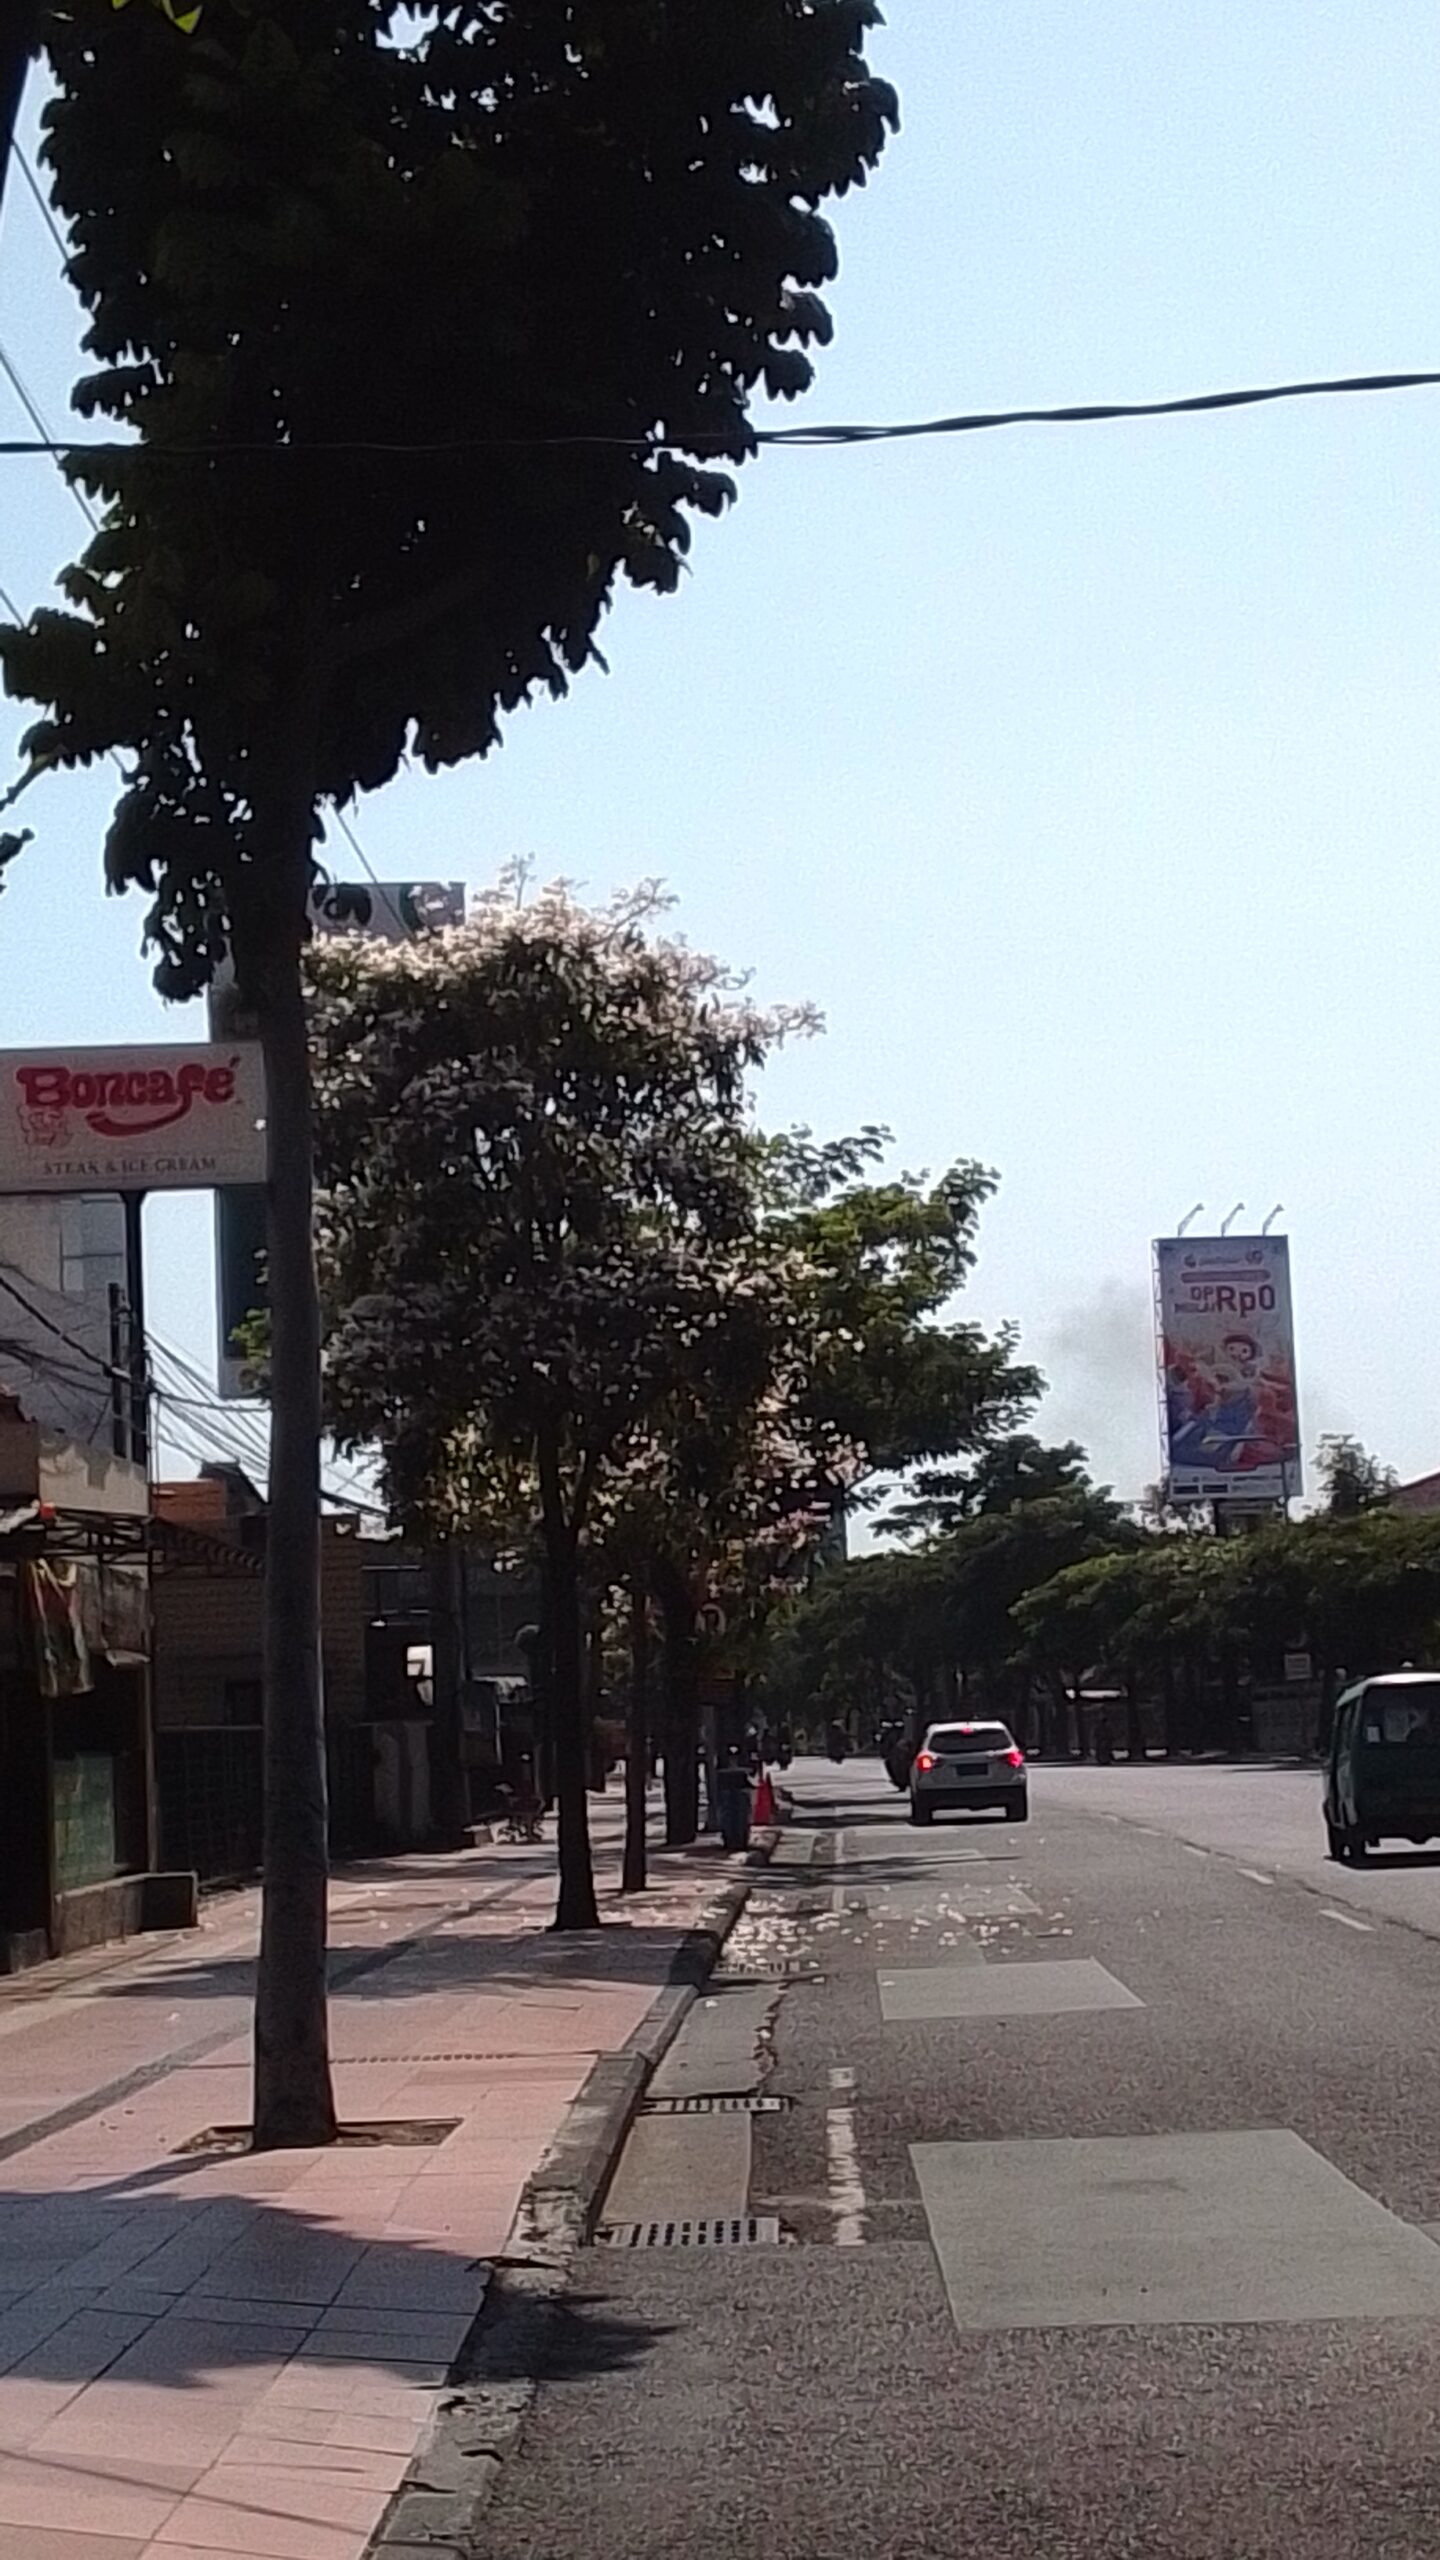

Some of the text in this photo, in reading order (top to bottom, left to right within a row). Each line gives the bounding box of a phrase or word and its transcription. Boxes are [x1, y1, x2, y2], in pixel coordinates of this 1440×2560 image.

[43, 1157, 216, 1175] STEAK & ICE CREAM
